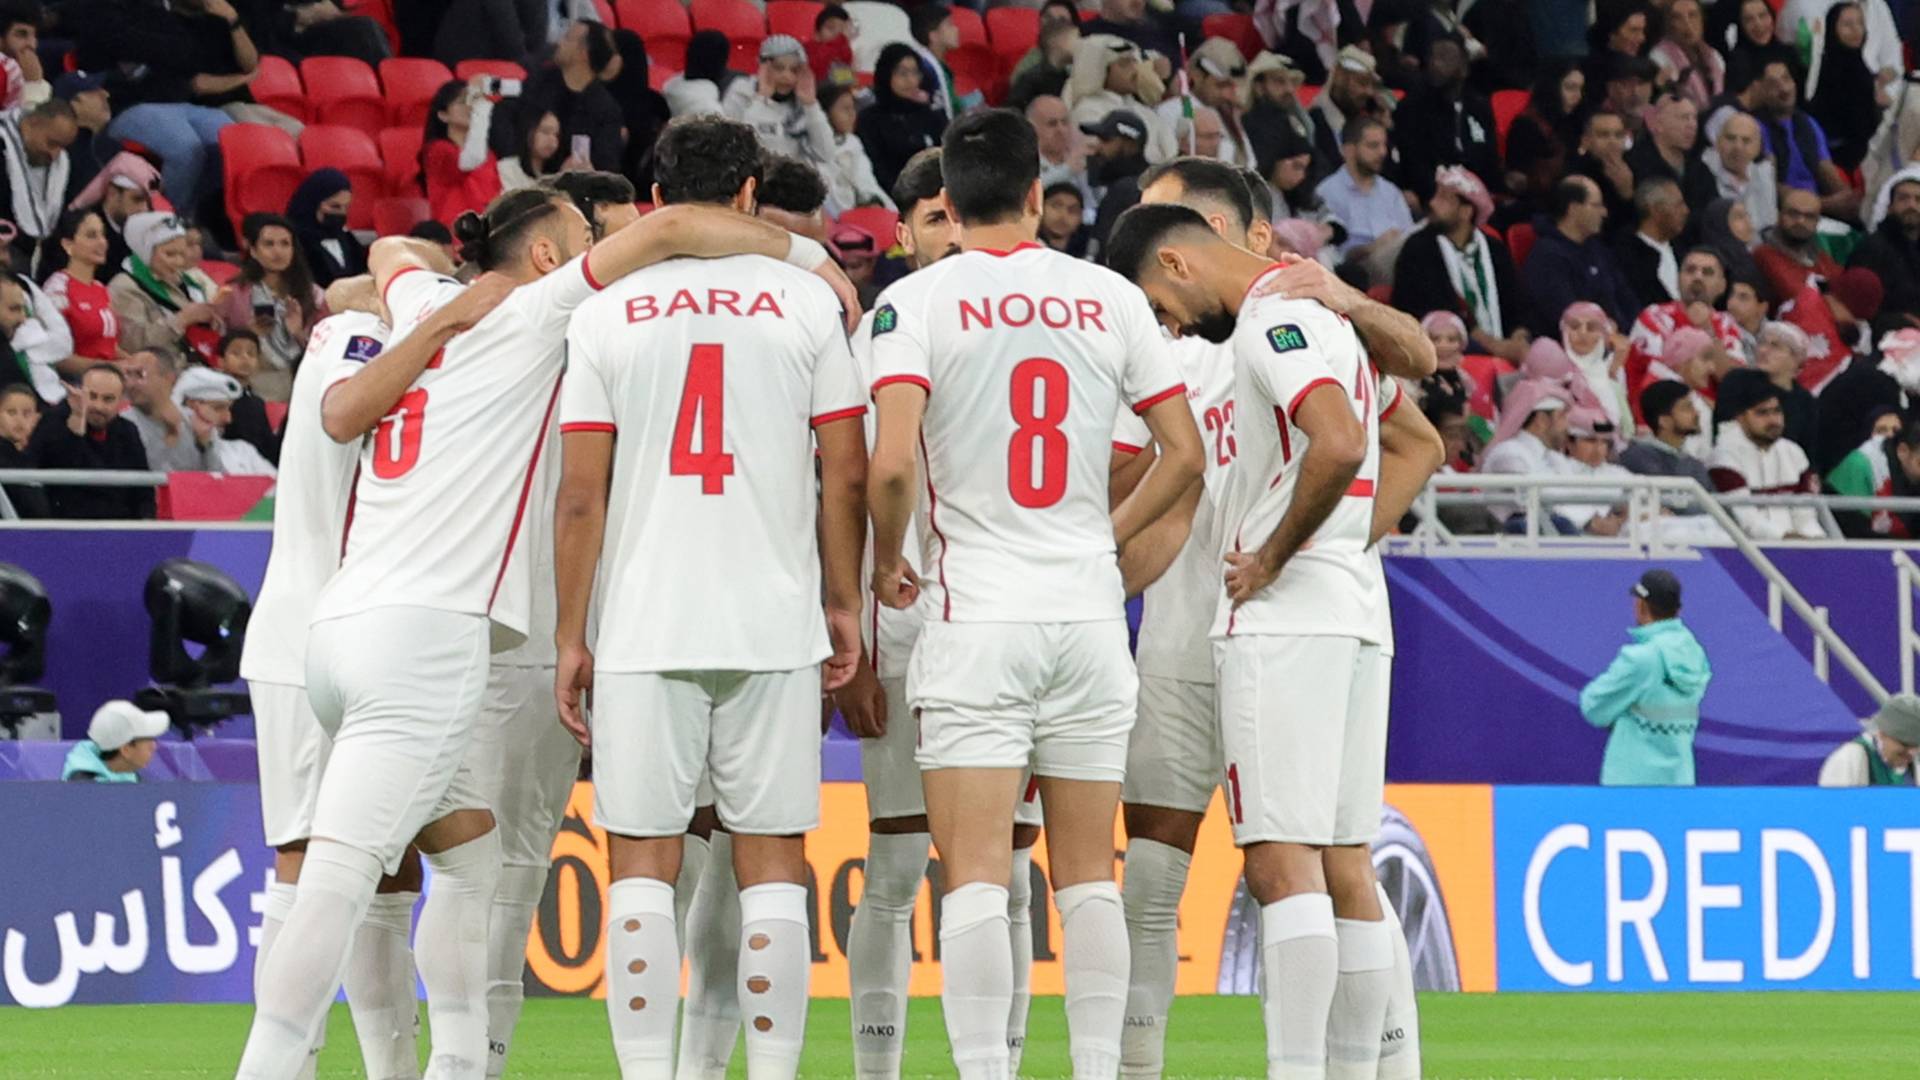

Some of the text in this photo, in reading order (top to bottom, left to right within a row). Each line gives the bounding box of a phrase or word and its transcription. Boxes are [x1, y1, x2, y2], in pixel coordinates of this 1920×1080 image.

[959, 293, 1107, 332] NOOR
[669, 343, 734, 495] 4
[1007, 357, 1070, 509] 8
[859, 1023, 895, 1037] JAKO
[1381, 1027, 1404, 1042] AKO
[489, 1039, 505, 1055] KO
